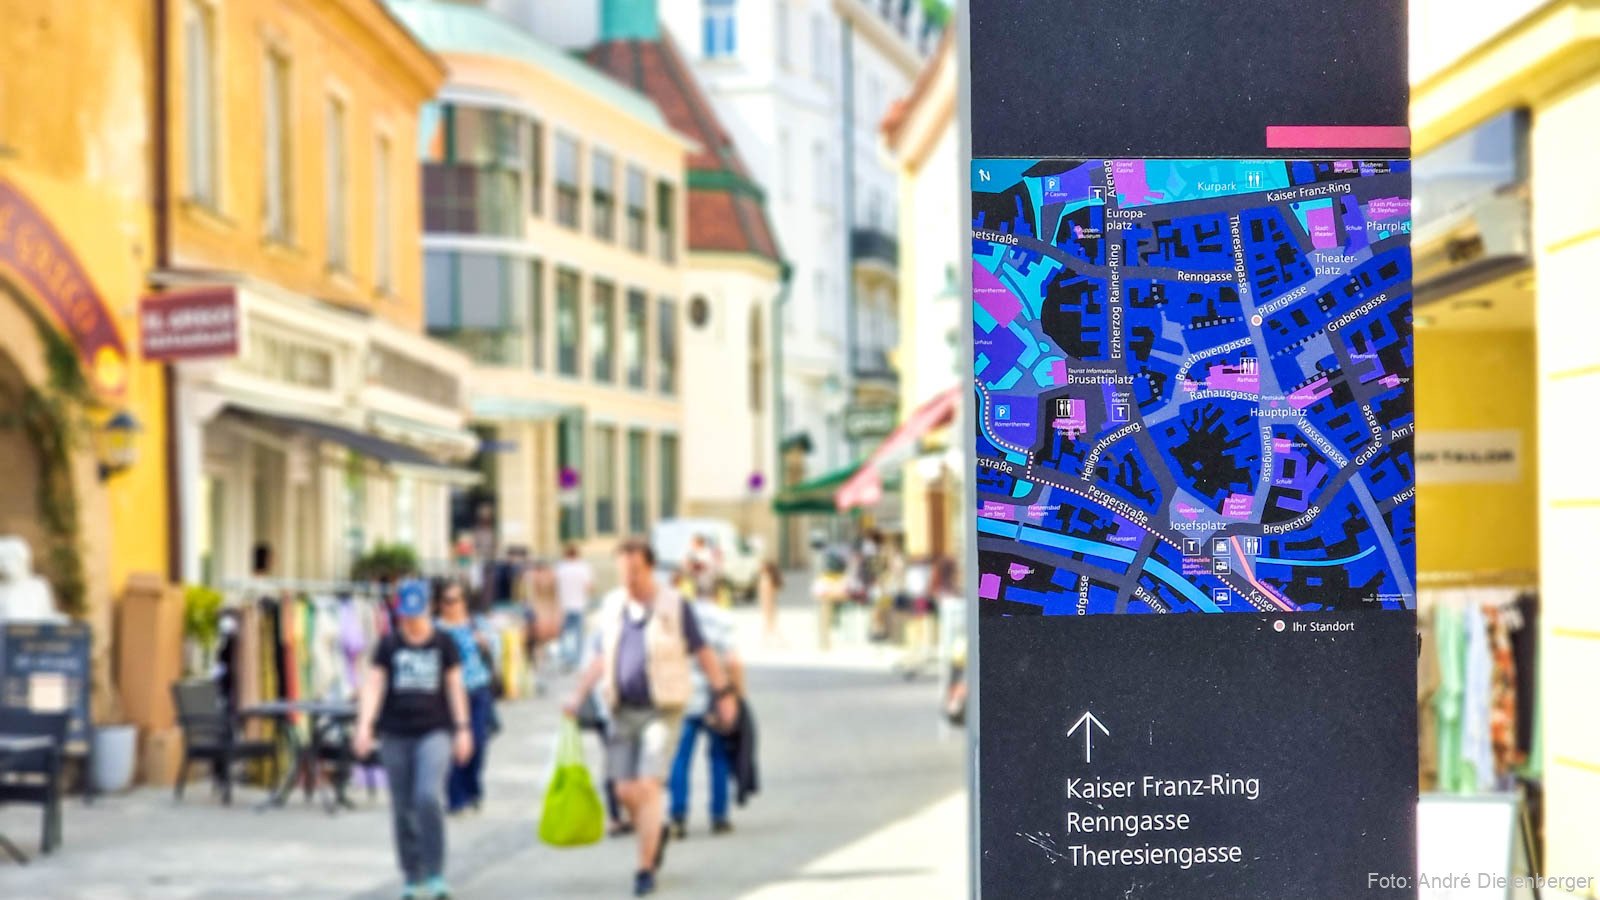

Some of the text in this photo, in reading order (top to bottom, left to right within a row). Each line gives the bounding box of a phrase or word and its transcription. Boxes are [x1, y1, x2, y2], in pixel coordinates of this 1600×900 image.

[1197, 182, 1236, 192] Kurpark
[1266, 183, 1350, 202] Kaiser Franz-Ring
[1106, 208, 1146, 219] Europa-
[1106, 220, 1132, 232] platz
[1230, 214, 1248, 294] Theresiengasse
[1315, 254, 1358, 263] Theater-
[1178, 270, 1232, 283] Renngasse
[1315, 266, 1341, 276] platz
[1109, 244, 1122, 358] Erzherzog Rainer-Ring
[1258, 286, 1308, 317] Pfarrgasse
[1328, 294, 1388, 332] Grabengasse
[1176, 337, 1252, 381] Beethovengasse
[1068, 375, 1134, 386] Brusattiplatz
[1190, 389, 1259, 402] Rathausgasse
[1116, 406, 1124, 417] T
[1250, 408, 1308, 419] Hauptplatz
[1298, 417, 1348, 468] Wassergasse
[1391, 428, 1408, 440] Am
[1081, 422, 1142, 482] Heiligenkreuzerg.
[1262, 426, 1272, 482] Frauengasse
[1088, 485, 1148, 524] Pergerstraße
[1170, 520, 1226, 532] Josefsplatz
[1264, 506, 1320, 535] Breyerstraße
[1188, 541, 1196, 552] T
[1076, 576, 1089, 616] ofgasse
[1135, 586, 1166, 614] Braitne
[1250, 588, 1277, 612] Kaiser
[1293, 622, 1354, 632] Ihr Standort
[1067, 773, 1260, 800] Kaiser Franz-Ring
[1067, 812, 1190, 836] Renngasse
[1068, 843, 1242, 869] Theresiengasse
